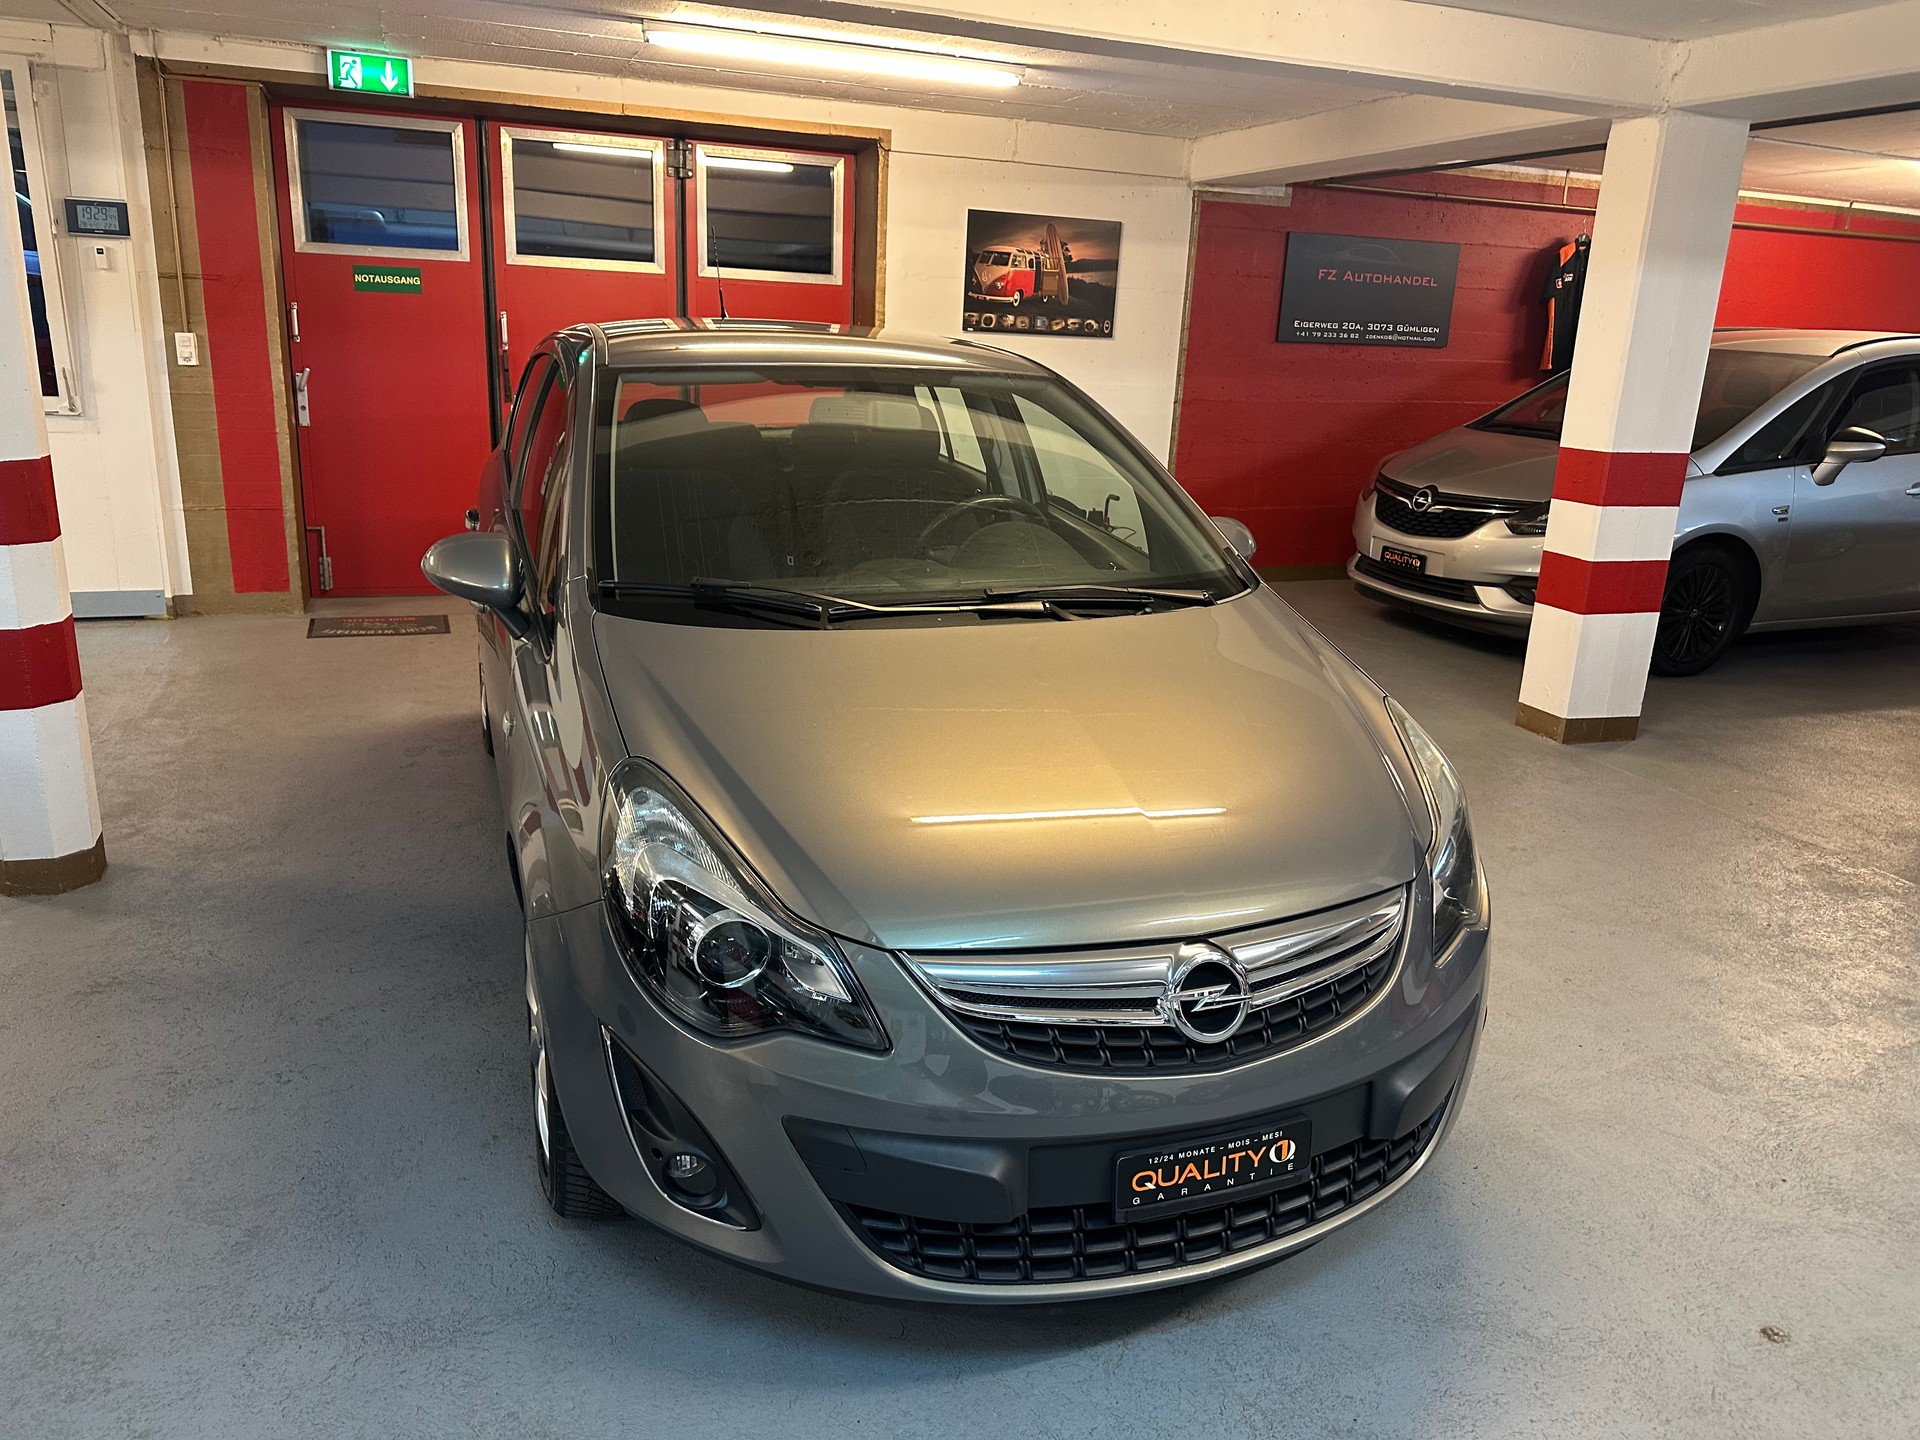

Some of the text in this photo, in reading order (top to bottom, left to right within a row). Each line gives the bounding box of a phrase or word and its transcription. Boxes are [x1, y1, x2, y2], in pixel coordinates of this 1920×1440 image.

[354, 274, 421, 285] NOTAUSGANG
[1318, 269, 1438, 287] FZ AUTOHANDEL
[1294, 320, 1440, 333] EIGERWEG 20A, 3073 GÜMLIGEN
[1384, 551, 1413, 564] QUALITY
[1148, 1154, 1174, 1165] 12/24
[1178, 1145, 1216, 1159] MONATE
[1227, 1137, 1250, 1149] MOIS
[1262, 1130, 1283, 1142] MESI
[1131, 1146, 1267, 1192] QUALITY
[1132, 1162, 1294, 1205] GARANTIE
